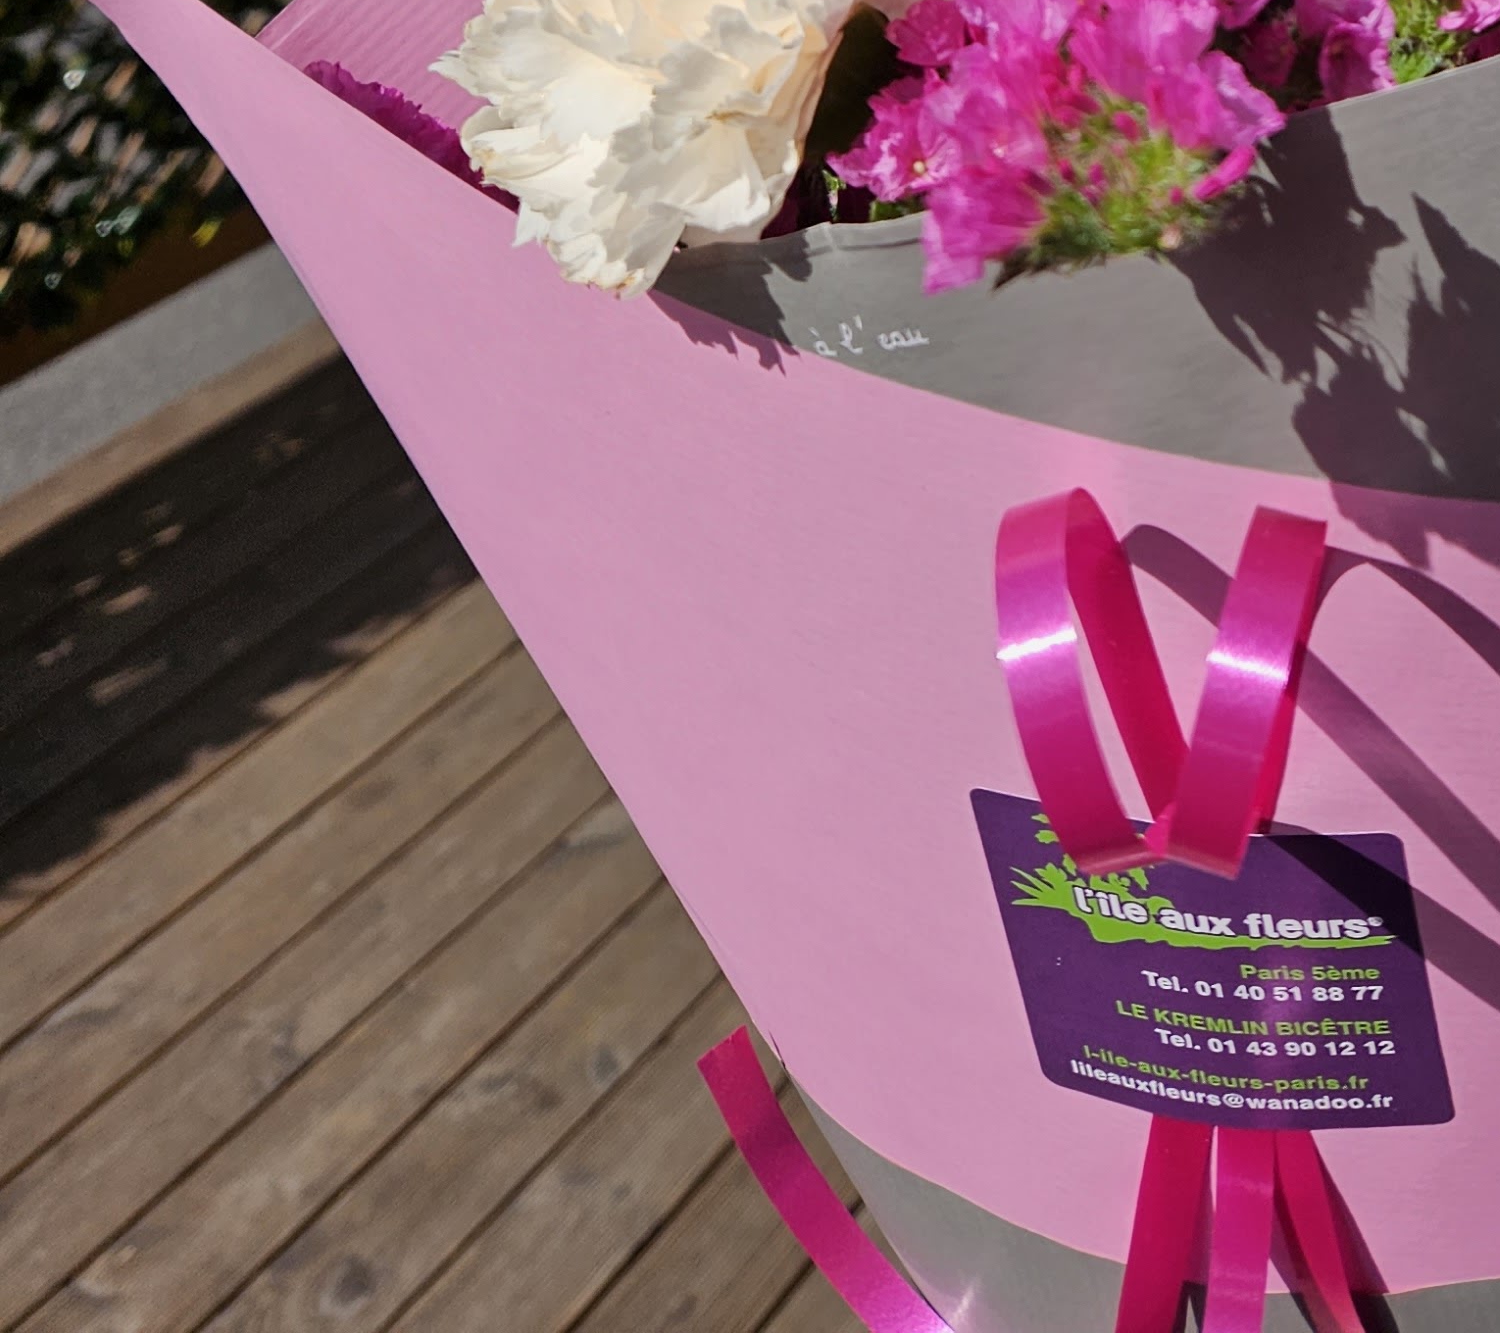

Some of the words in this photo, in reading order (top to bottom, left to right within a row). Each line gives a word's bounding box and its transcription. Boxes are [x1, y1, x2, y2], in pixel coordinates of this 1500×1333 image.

[1159, 907, 1237, 937] aux
[1140, 969, 1189, 994] Tel.
[1194, 980, 1224, 999] 01
[1233, 984, 1266, 1001] 40
[1272, 985, 1303, 1002] 51
[1311, 986, 1345, 1002] 88
[1350, 985, 1384, 1001] 77
[1239, 963, 1306, 981] Paris
[1311, 964, 1381, 982] 5ème
[1115, 999, 1150, 1020] LE
[1153, 1007, 1269, 1036] KREMLIN
[1275, 1017, 1392, 1036] BICÊTRE
[1153, 1027, 1201, 1051] Tel.
[1207, 1037, 1237, 1055] 01
[1245, 1041, 1278, 1057] 43
[1283, 1041, 1317, 1057] 90
[1323, 1041, 1357, 1057] 12
[1362, 1040, 1397, 1056] 12
[1070, 1059, 1394, 1111] lileauxfleurs@wanadoo.fr
